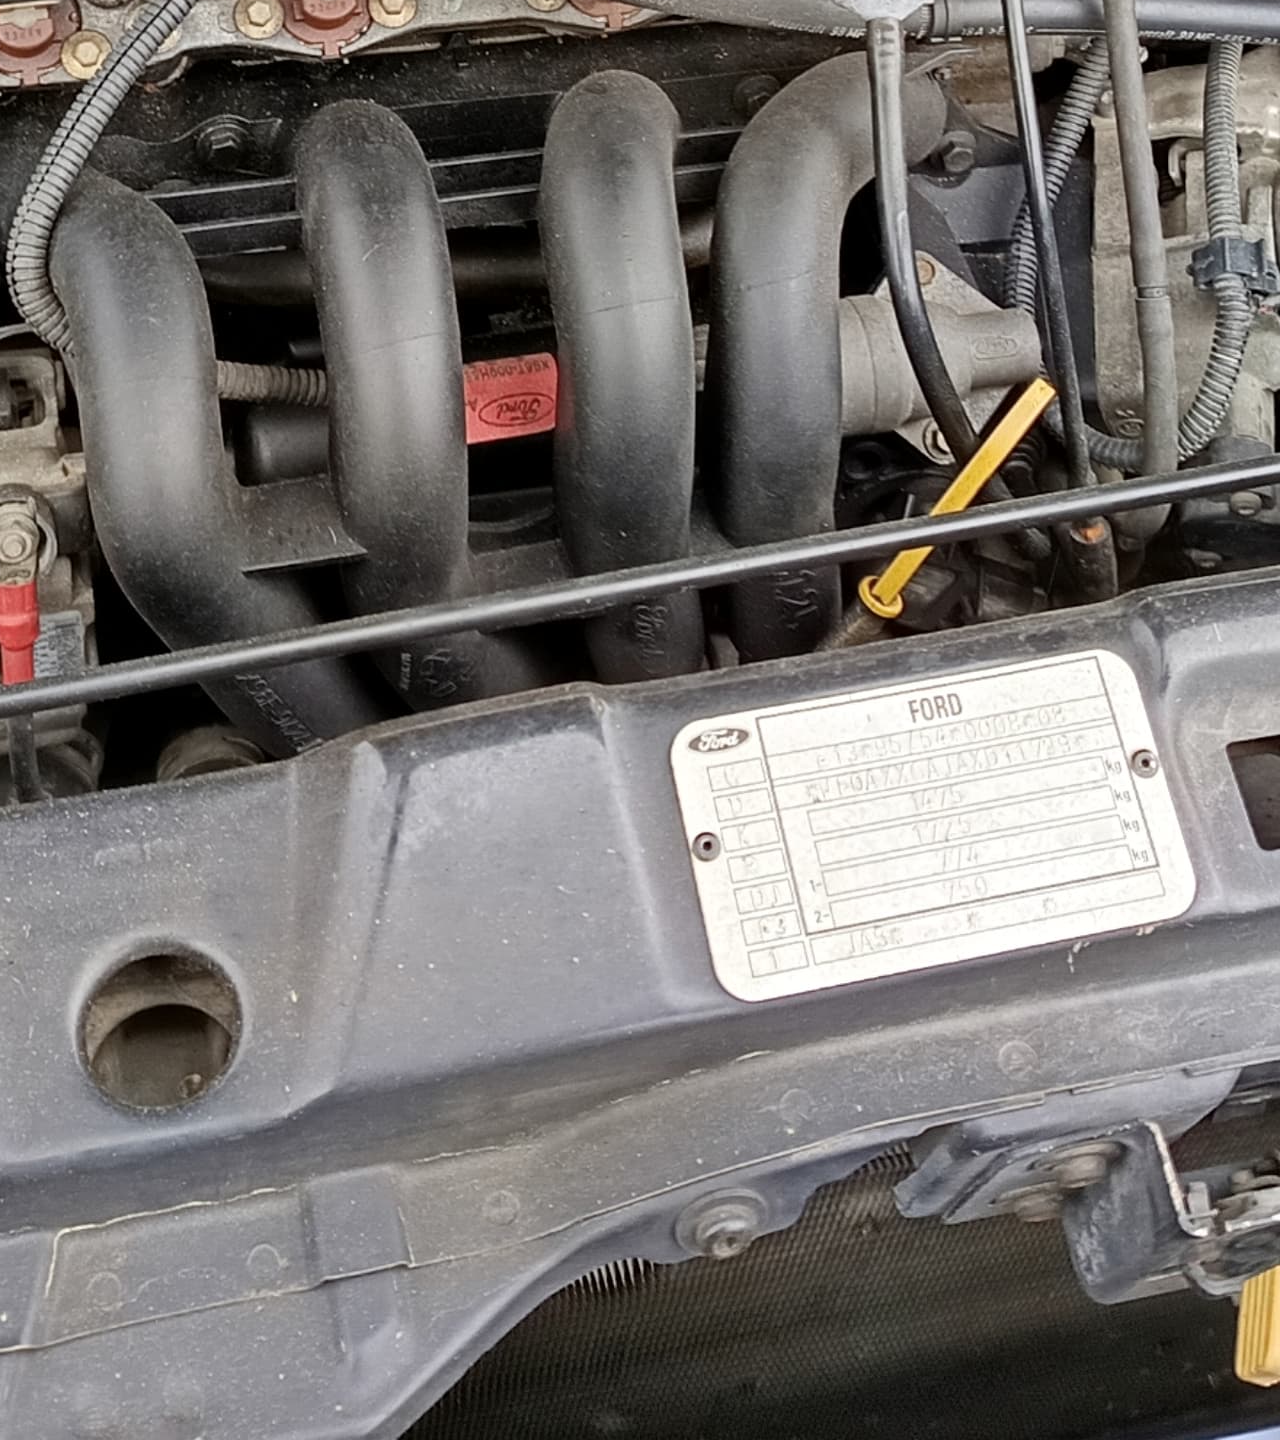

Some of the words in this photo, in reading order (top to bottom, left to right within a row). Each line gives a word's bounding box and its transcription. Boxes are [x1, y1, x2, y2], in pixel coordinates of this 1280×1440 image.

[905, 691, 965, 724] FORD
[1103, 757, 1124, 775] kg
[1113, 787, 1132, 803] kg
[1121, 816, 1142, 833] kg
[1130, 846, 1150, 864] kg
